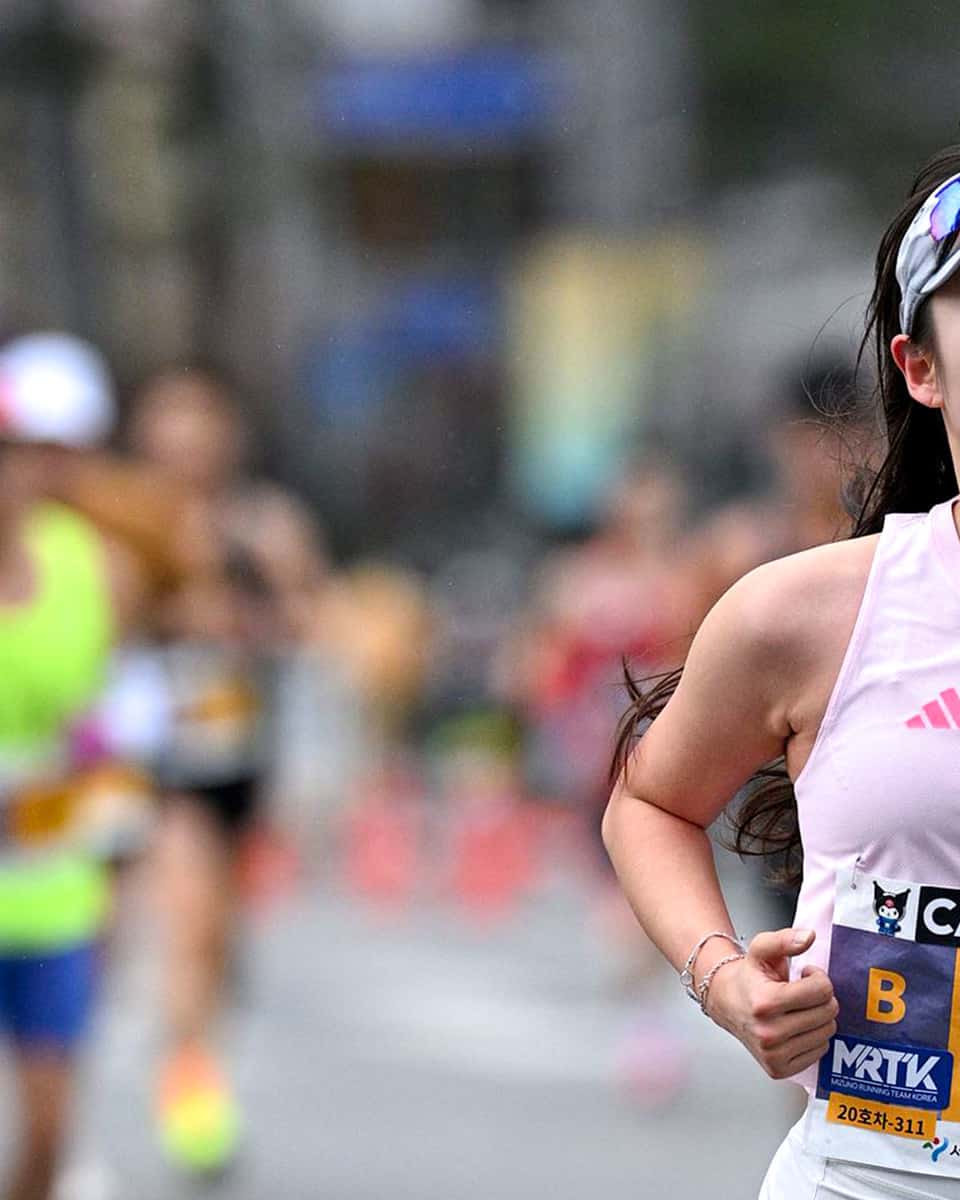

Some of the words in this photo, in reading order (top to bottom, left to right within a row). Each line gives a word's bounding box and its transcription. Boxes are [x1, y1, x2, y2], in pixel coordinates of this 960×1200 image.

[865, 967, 907, 1025] B
[831, 1039, 941, 1091] MRTK
[890, 1088, 912, 1100] TEAM
[912, 1091, 938, 1103] KOREA
[837, 1104, 925, 1136] 20호차-311
